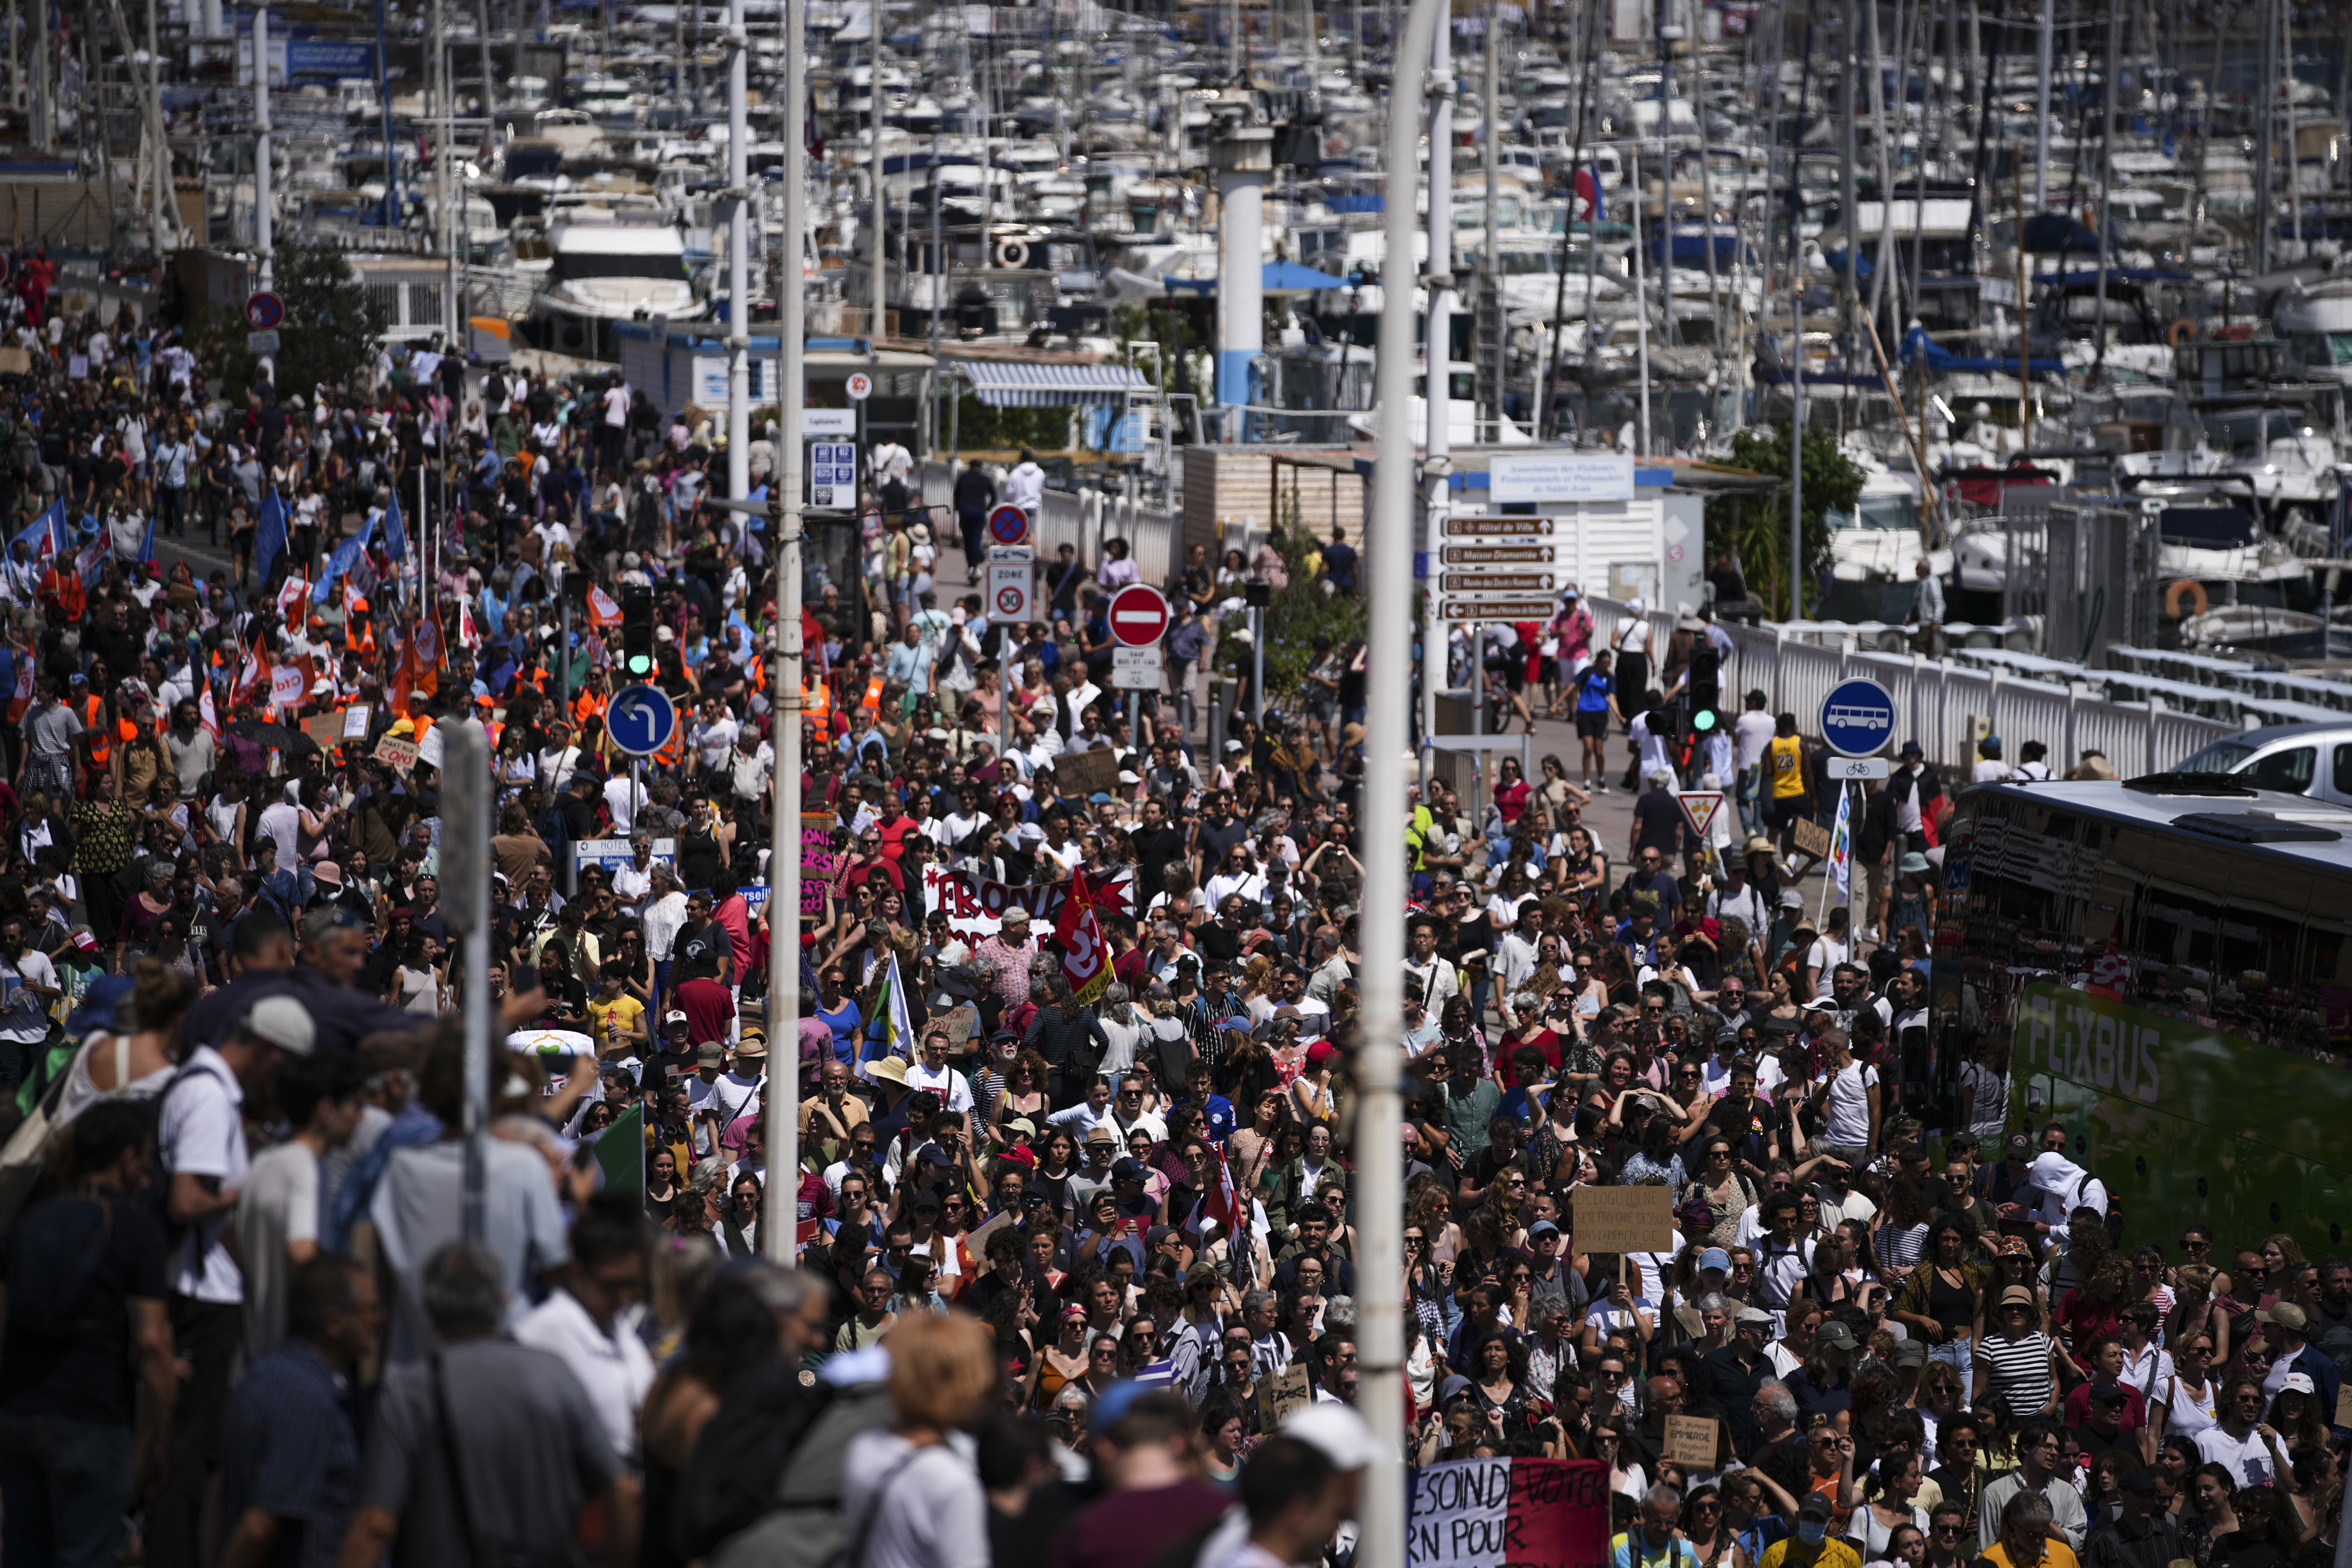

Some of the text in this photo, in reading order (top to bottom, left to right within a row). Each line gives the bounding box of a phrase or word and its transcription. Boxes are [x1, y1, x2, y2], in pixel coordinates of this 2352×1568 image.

[1478, 521, 1535, 531] Hôtel de Ville
[1464, 550, 1538, 559] Maison Diamantée
[998, 570, 1023, 579] ZONE
[1464, 578, 1482, 587] Musée
[1484, 579, 1493, 587] des
[1001, 593, 1019, 607] 30
[1479, 606, 1497, 614] Musée
[378, 747, 414, 765] CONS
[1777, 754, 1795, 770] 23
[1806, 823, 1822, 840] NO
[604, 857, 624, 867] Galeries
[1517, 971, 1543, 994] FRONT
[943, 1007, 968, 1021] FRONT
[578, 1042, 593, 1051] AIMER
[664, 1064, 678, 1074] 85
[1644, 1191, 1658, 1205] NE
[1598, 1211, 1613, 1224] PAS
[1637, 1212, 1669, 1225] DESSUS
[1574, 1229, 1596, 1242] DANS
[1643, 1230, 1658, 1242] DE
[1604, 1241, 1648, 1252] TOLBIAC
[1279, 1369, 1302, 1381] AVENIR
[1669, 1417, 1682, 1426] La
[1671, 1429, 1710, 1443] EMMERDE
[1677, 1440, 1708, 1452] toujours
[1452, 1515, 1526, 1561] POUR
